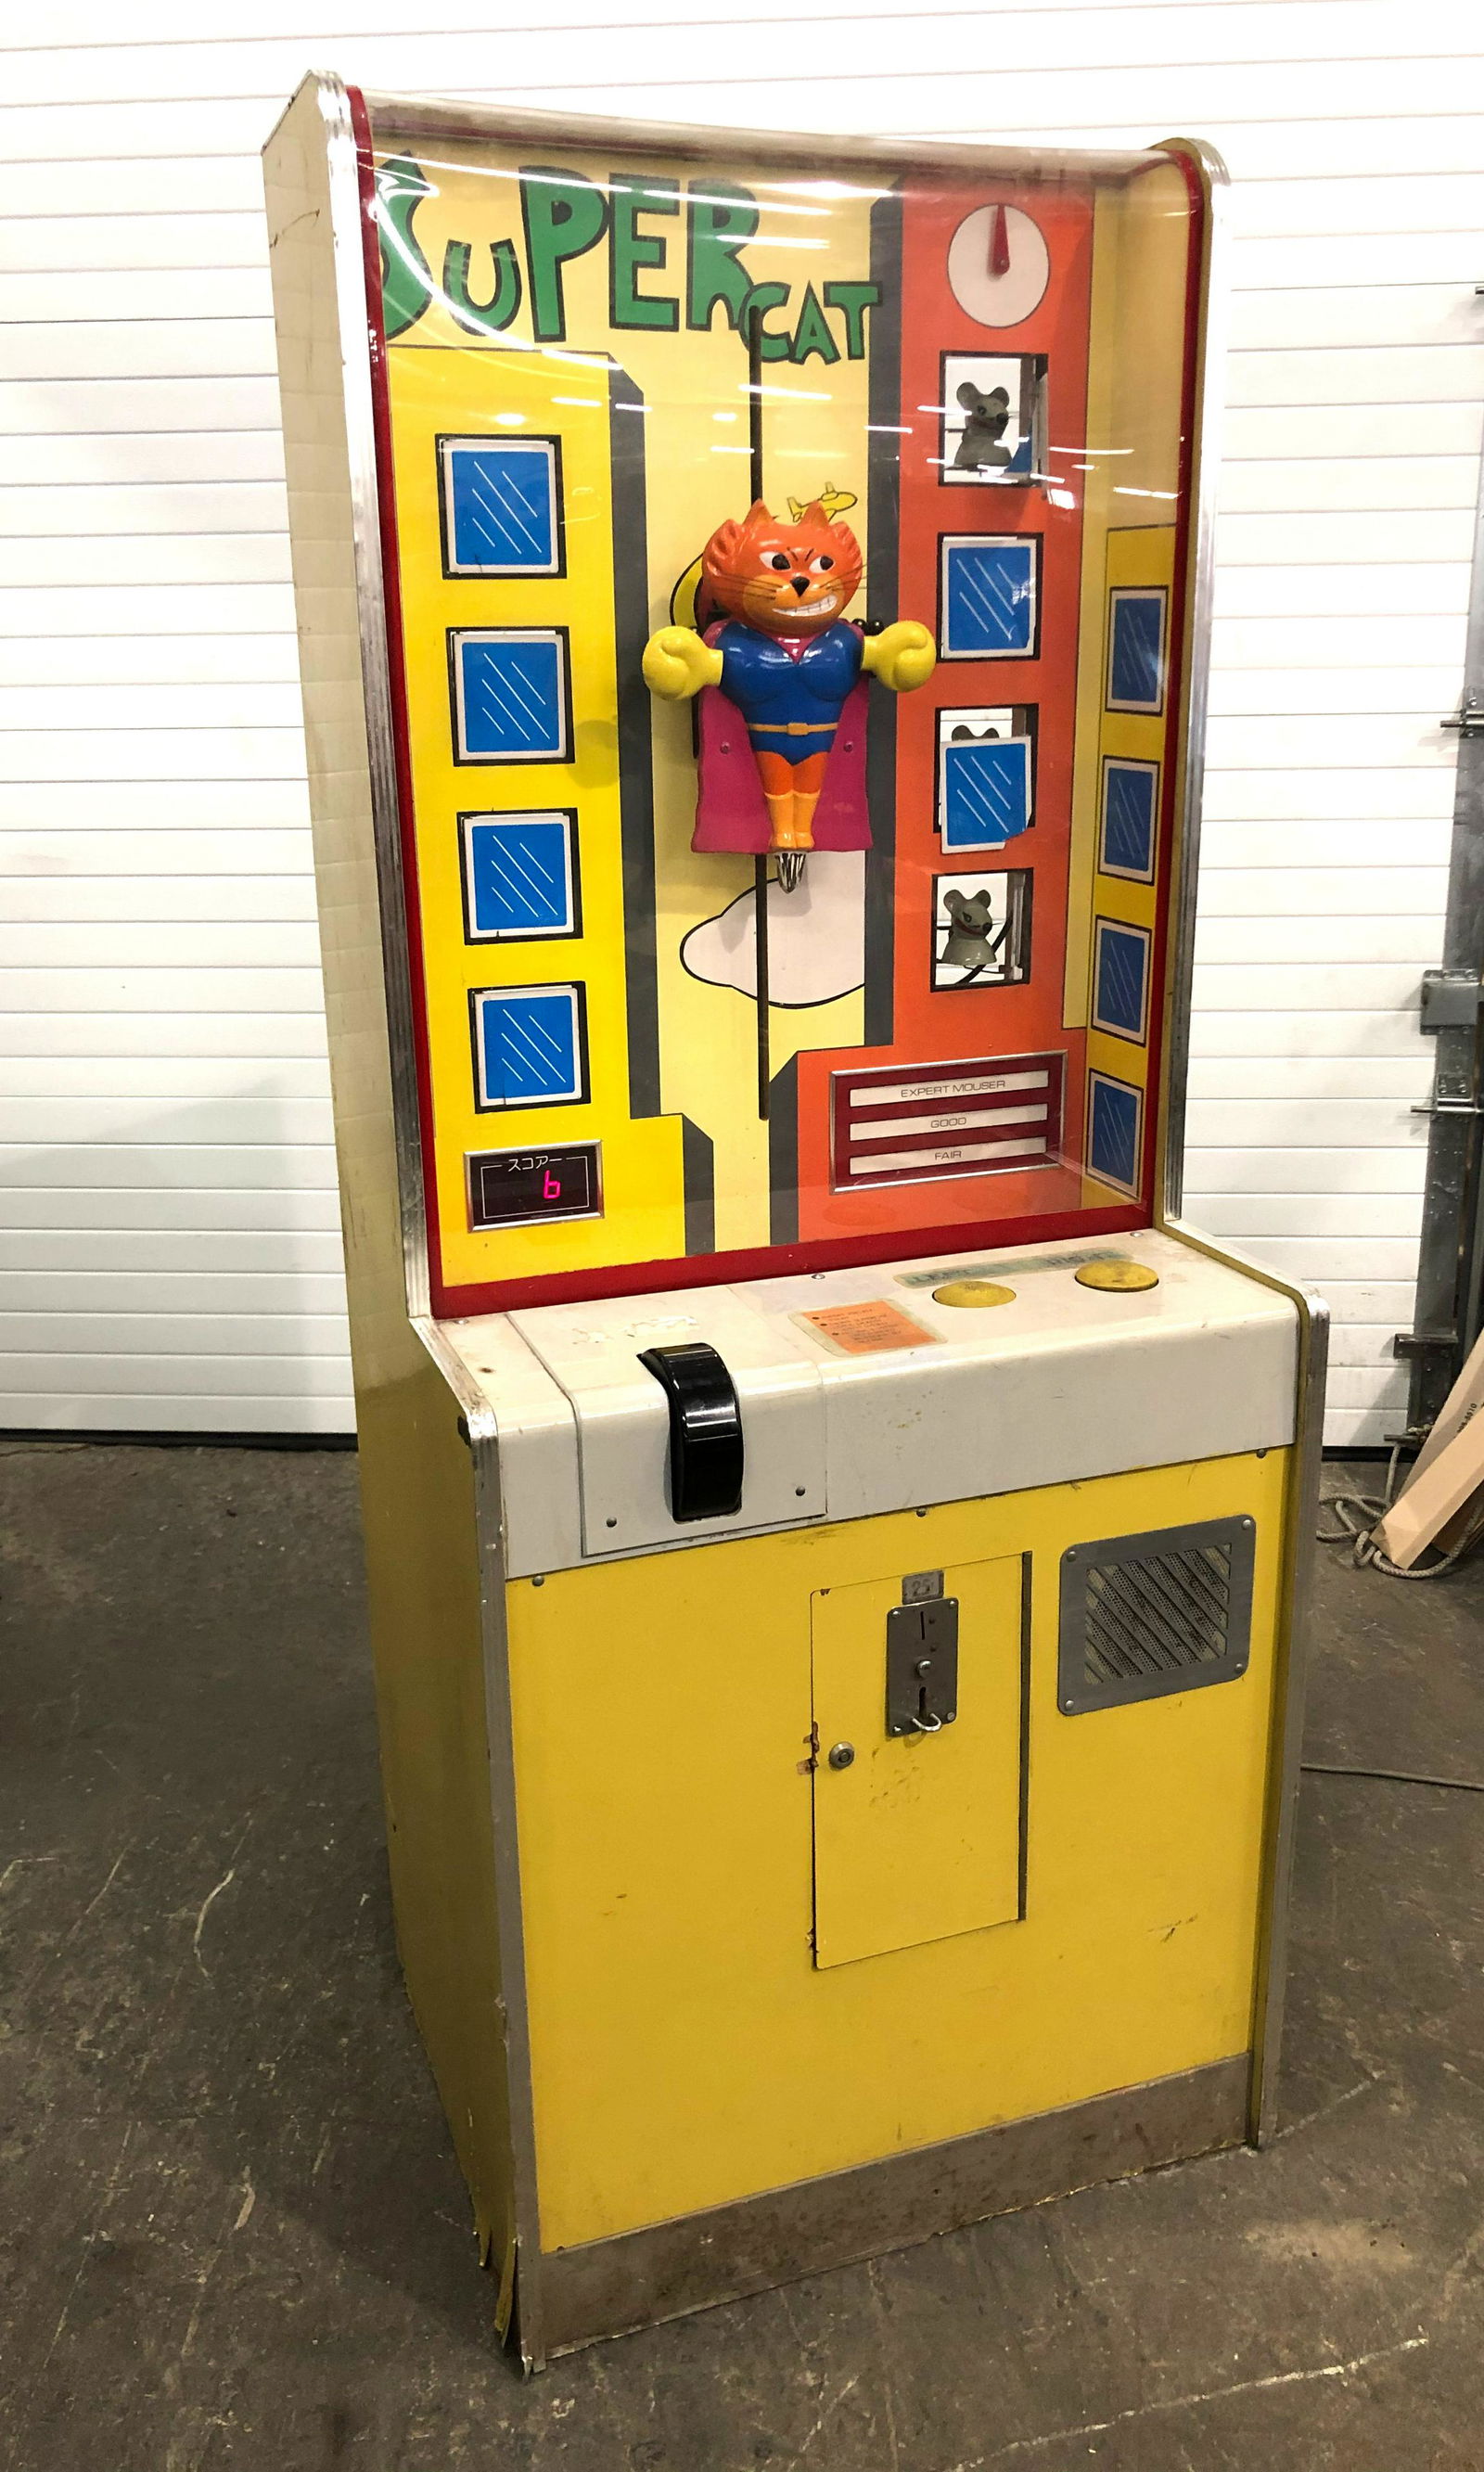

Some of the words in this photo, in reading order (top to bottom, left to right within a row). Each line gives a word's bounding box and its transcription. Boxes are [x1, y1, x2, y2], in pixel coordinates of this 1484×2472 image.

[374, 149, 760, 344] SUPER
[738, 280, 884, 365] CAT
[900, 1084, 950, 1098] EXPERT
[952, 1080, 1006, 1094] MOUSER
[930, 1116, 967, 1129] GOOD
[507, 1155, 563, 1172] スコアー
[934, 1149, 962, 1161] FAIR
[543, 1169, 561, 1199] 6
